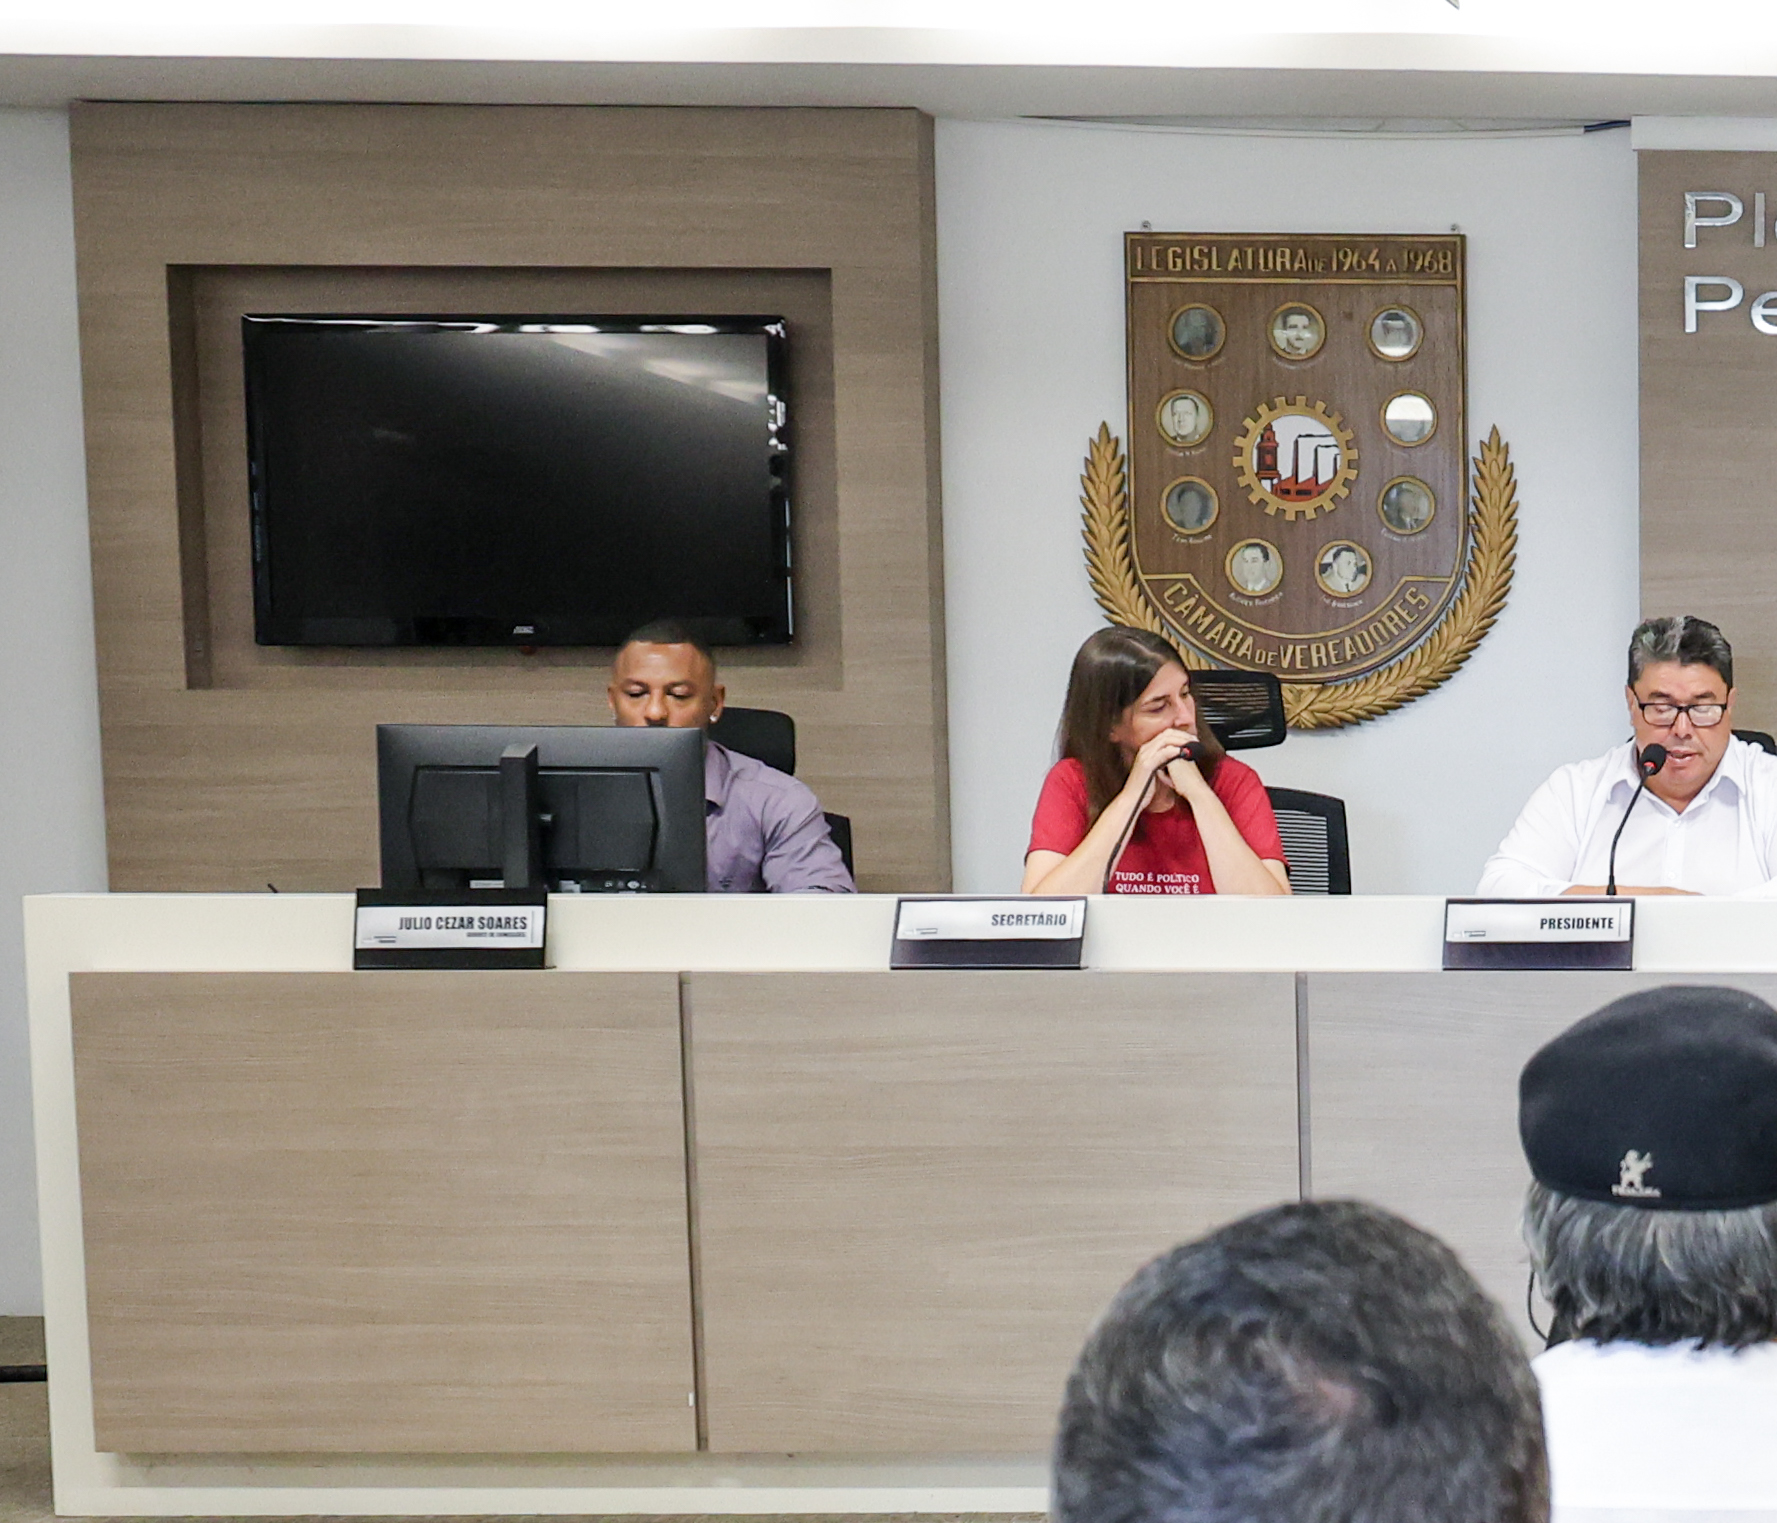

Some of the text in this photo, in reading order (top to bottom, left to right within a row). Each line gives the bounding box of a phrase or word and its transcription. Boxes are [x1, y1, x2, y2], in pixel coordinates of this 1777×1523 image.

[1136, 246, 1307, 272] LEGISLATURA
[1255, 649, 1278, 666] DE
[1280, 587, 1431, 669] VEREADORES
[1115, 871, 1144, 881] TUDO
[1115, 883, 1162, 893] QUANDO
[1164, 883, 1190, 894] VOCÊ
[399, 916, 528, 930] JULIO CEZAR SOARES
[991, 912, 1067, 926] SECRETÁRIO
[1540, 917, 1614, 930] PRESIDENTE
